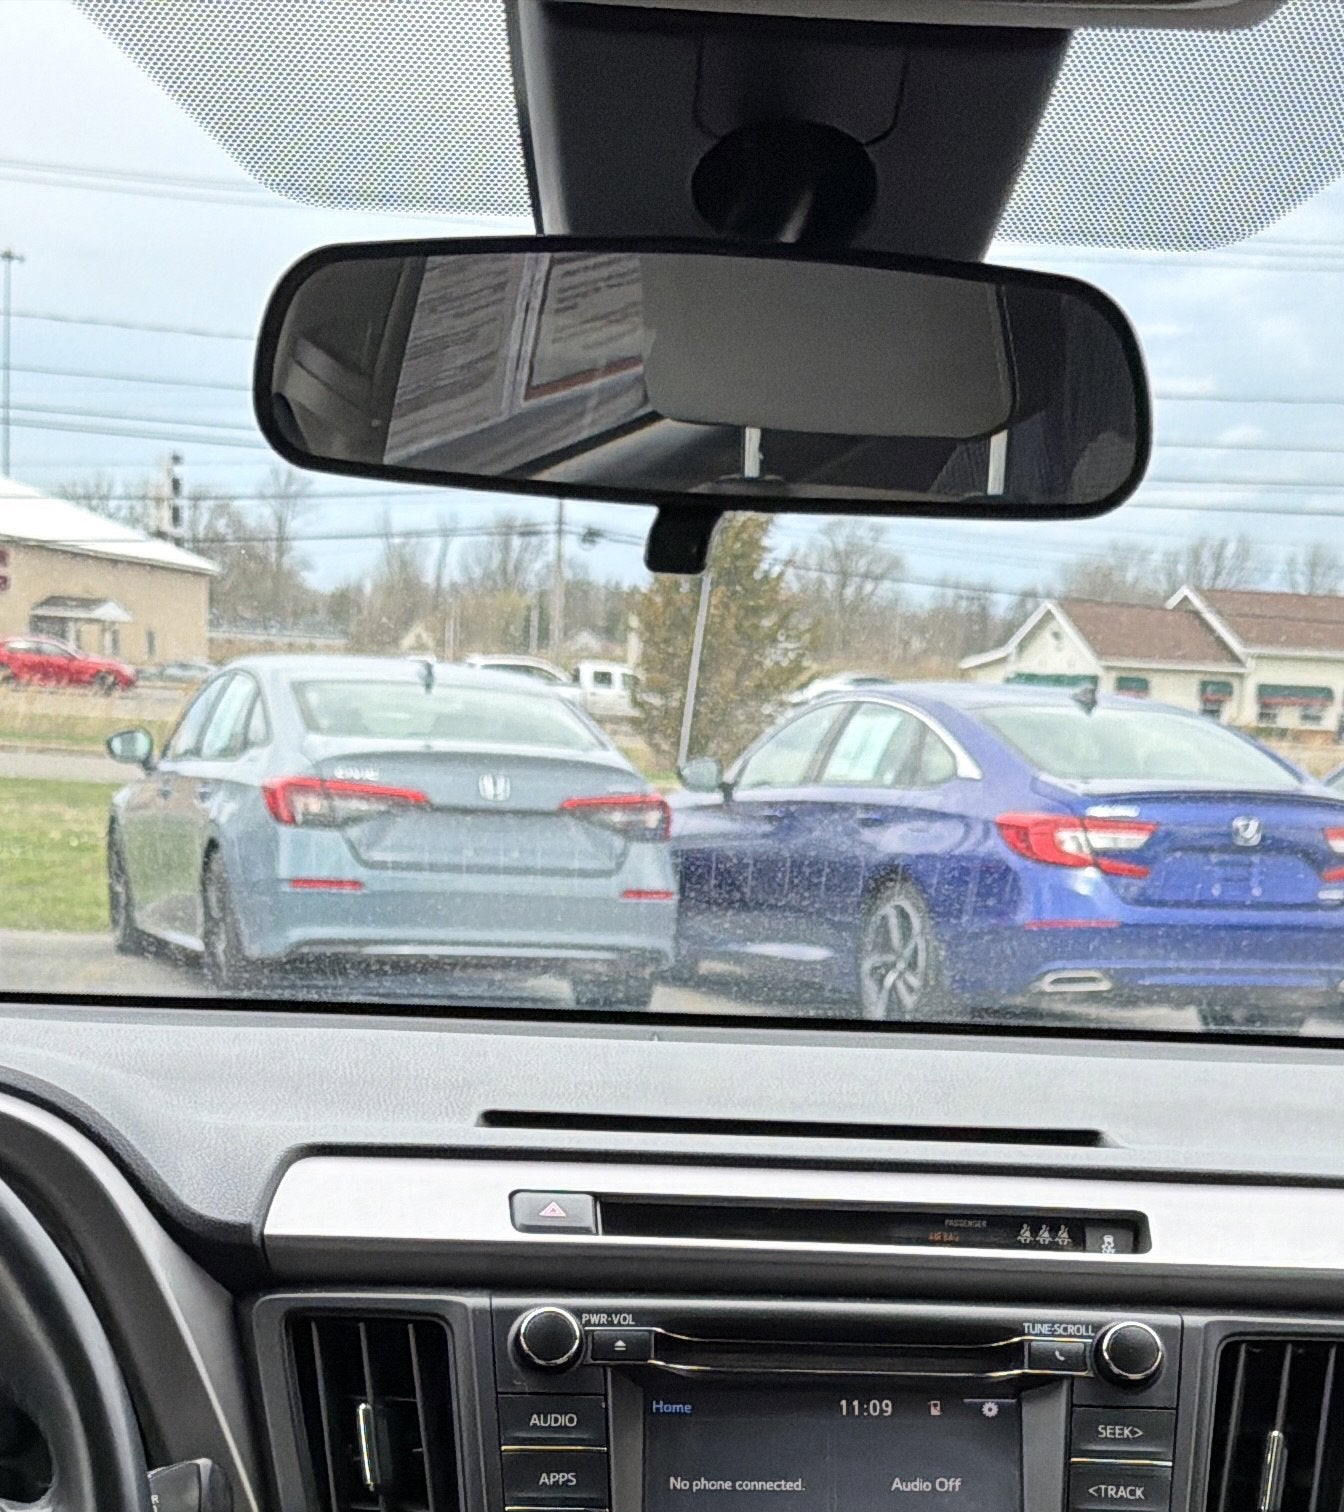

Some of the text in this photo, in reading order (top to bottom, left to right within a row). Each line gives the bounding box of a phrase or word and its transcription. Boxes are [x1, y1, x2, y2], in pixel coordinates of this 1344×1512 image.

[652, 1400, 692, 1414] Home
[839, 1399, 893, 1417] 11:09
[529, 1413, 578, 1428] AUDIO
[538, 1472, 577, 1487] APPS
[669, 1476, 806, 1492] No phone connected.
[891, 1477, 962, 1492] Audio Off
